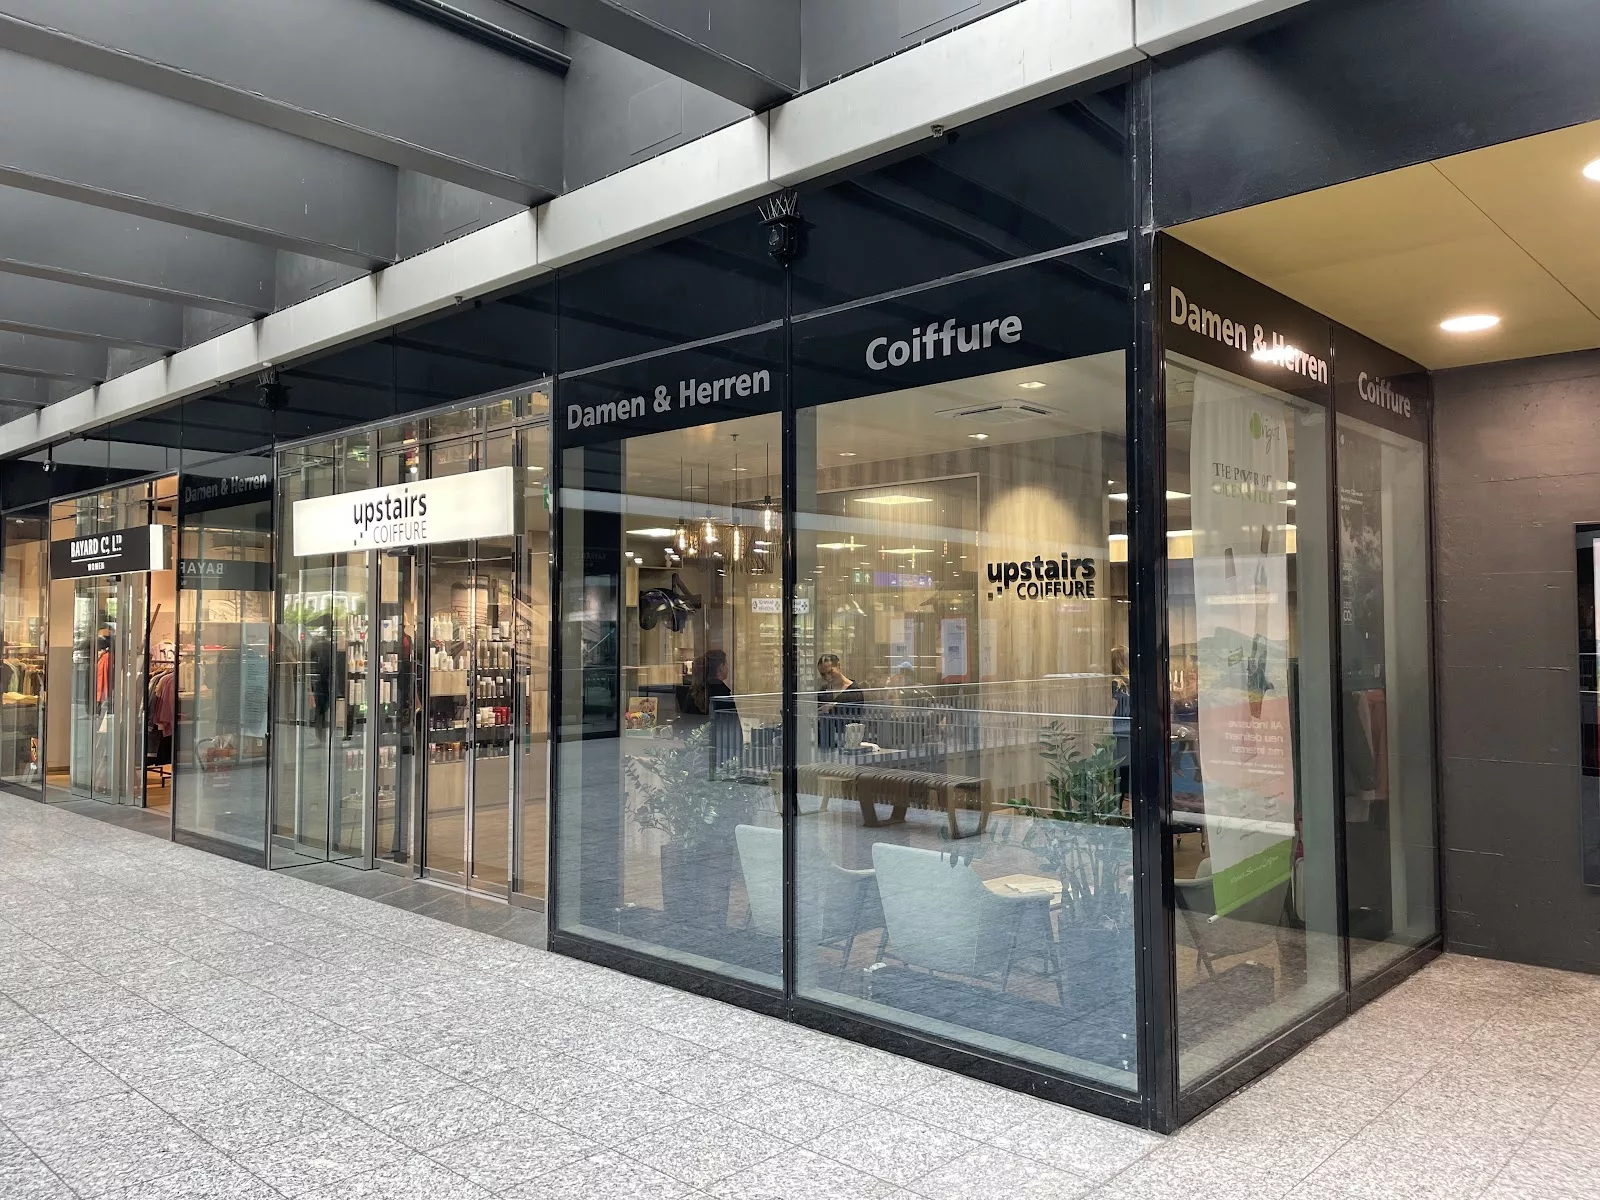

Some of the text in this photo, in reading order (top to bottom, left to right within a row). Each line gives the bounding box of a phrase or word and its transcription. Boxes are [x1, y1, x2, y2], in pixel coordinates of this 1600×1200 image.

[866, 315, 1023, 371] Coiffure
[1170, 286, 1328, 385] Damen & Herren
[567, 369, 770, 430] Damen & Herren
[1358, 371, 1411, 418] Coiffure
[184, 473, 267, 503] Damen & Herren
[353, 488, 427, 532] upstairs
[70, 538, 98, 557] BAYARD
[373, 520, 427, 544] COIFFURE
[987, 552, 1096, 589] upstairs
[1016, 580, 1095, 600] COIFFURE
